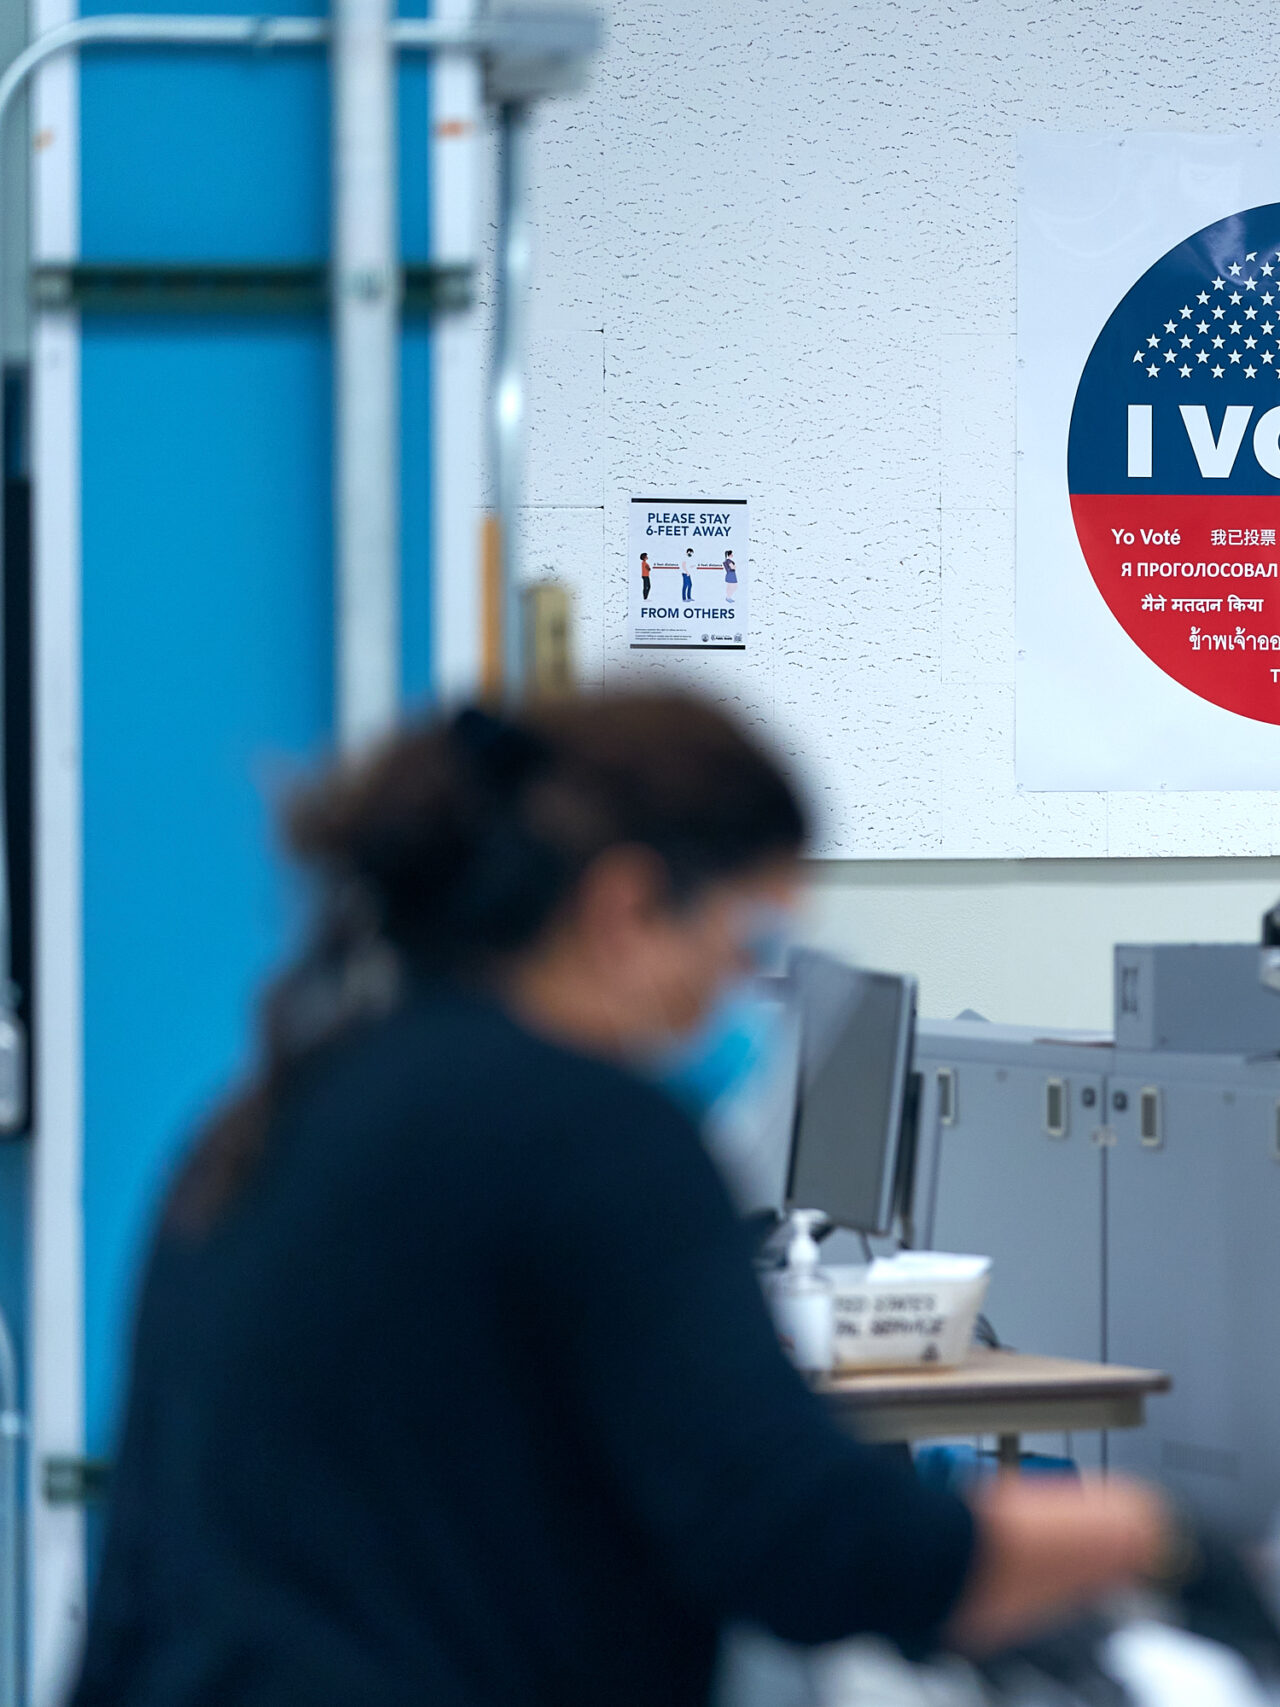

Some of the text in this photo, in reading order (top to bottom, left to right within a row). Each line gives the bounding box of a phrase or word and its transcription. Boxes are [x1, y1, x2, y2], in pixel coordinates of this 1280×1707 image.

[1127, 404, 1153, 478] I
[647, 512, 731, 524] PLEASE STAY
[646, 525, 732, 537] 6-FEET AWAY
[1111, 529, 1181, 545] Yo Voté
[1210, 529, 1277, 547] 我已投票
[1120, 563, 1278, 578] Я ПРОГОЛОСОВАЛ
[1171, 598, 1224, 613] मतदान
[1227, 594, 1265, 612] किया
[640, 607, 736, 620] FROM OTHERS
